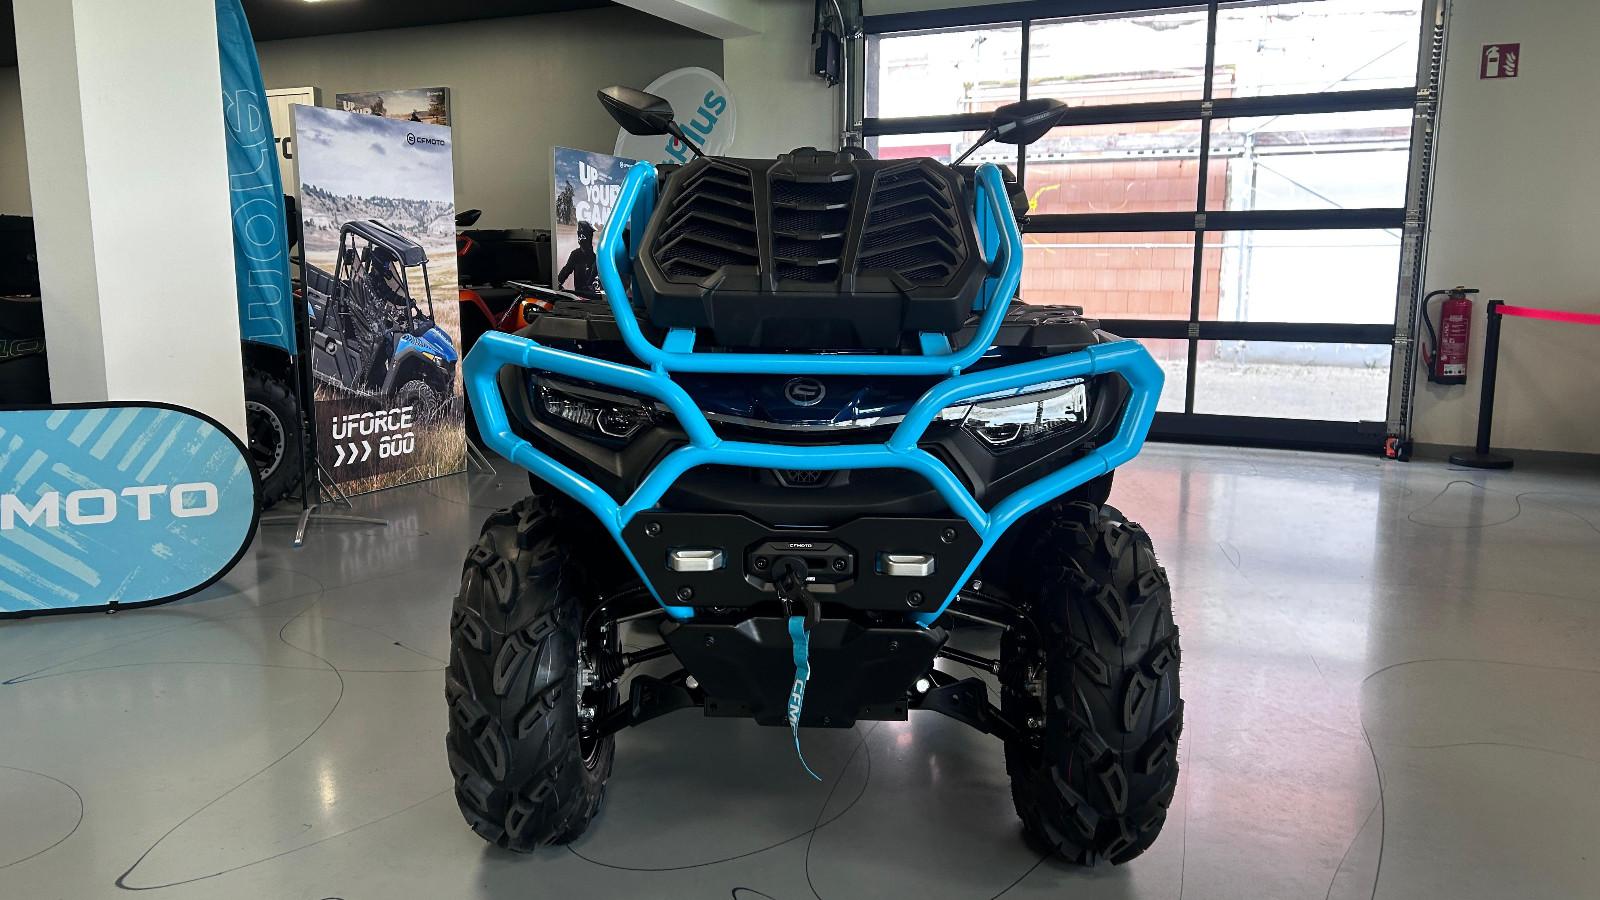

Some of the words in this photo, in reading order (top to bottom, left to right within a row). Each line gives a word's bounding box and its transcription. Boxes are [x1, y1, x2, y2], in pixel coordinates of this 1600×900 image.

[416, 136, 446, 146] CFMOTO
[579, 160, 599, 186] UP
[332, 405, 414, 440] UFORCE
[379, 431, 415, 459] 600
[1, 481, 219, 530] MOTO
